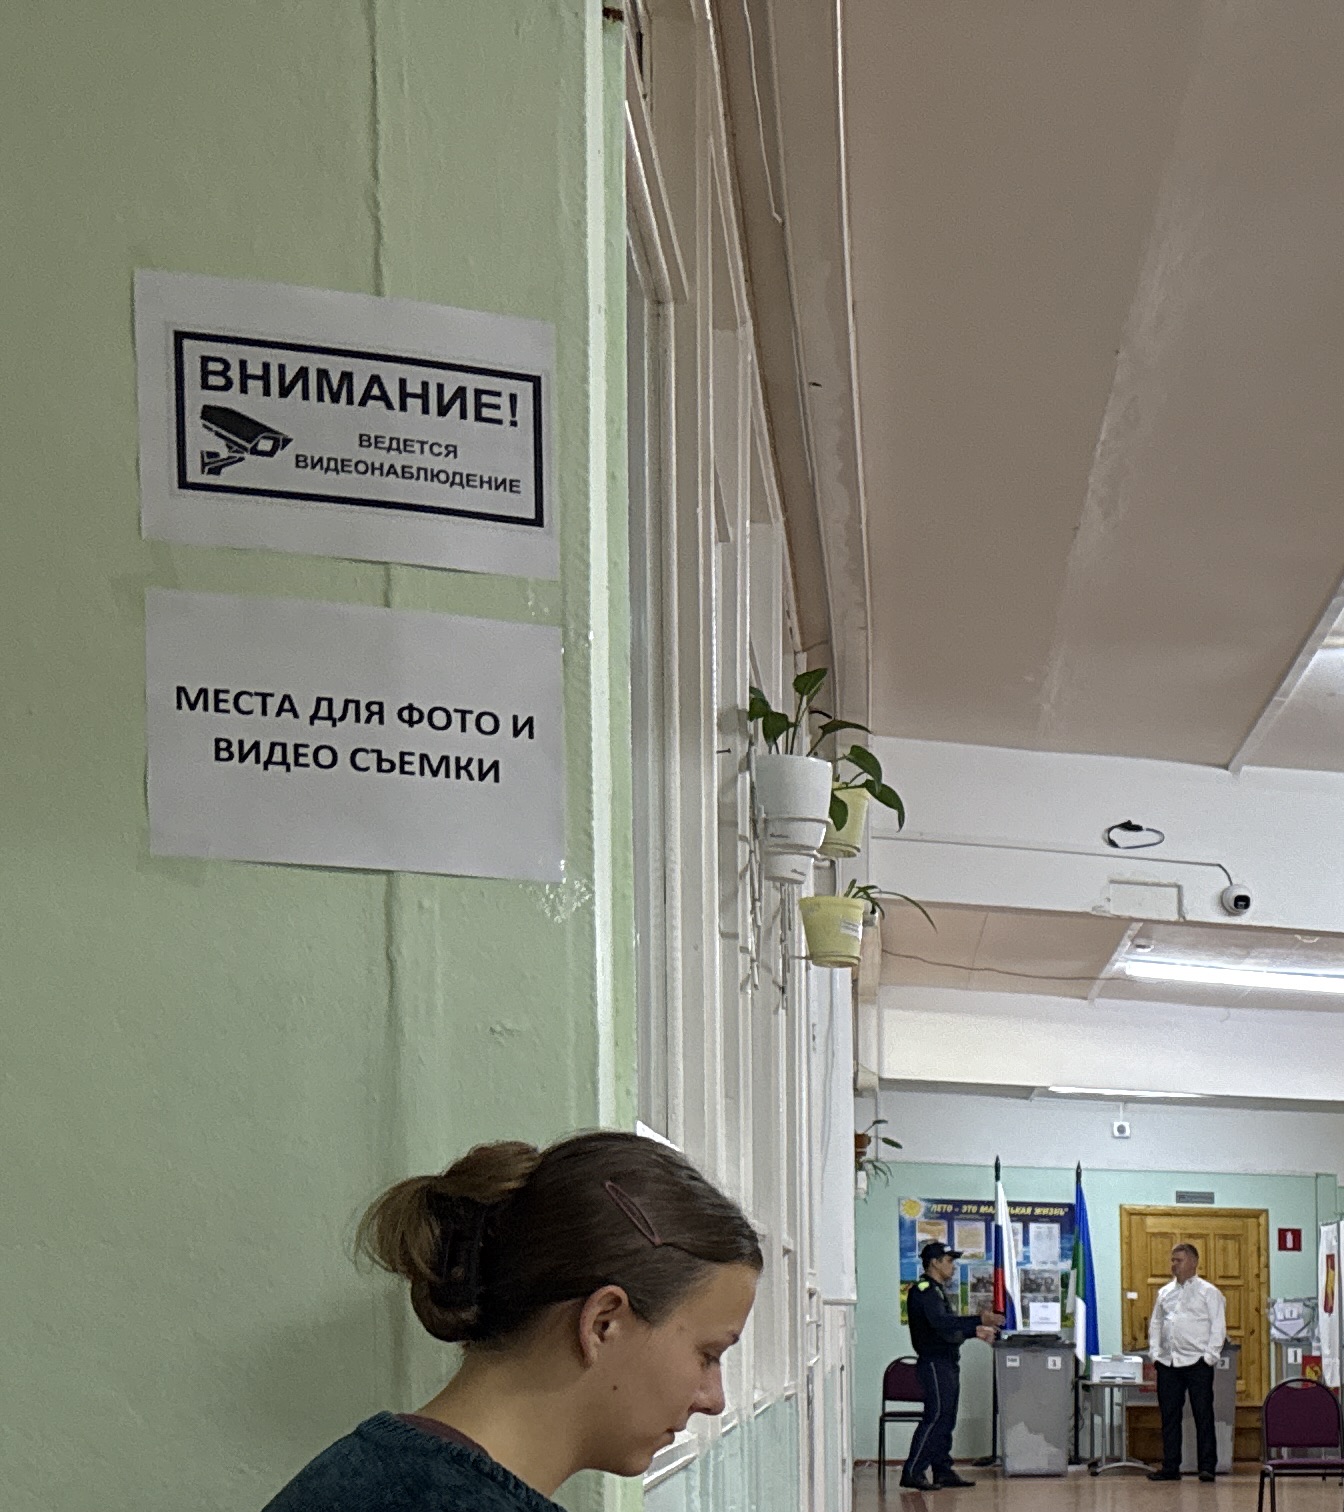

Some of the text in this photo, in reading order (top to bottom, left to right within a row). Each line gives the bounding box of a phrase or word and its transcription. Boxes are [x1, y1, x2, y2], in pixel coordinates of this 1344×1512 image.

[200, 355, 519, 428] ВНИМАНИЕ!
[358, 432, 458, 460] ВЕДЕТСЯ
[294, 453, 522, 495] ВИДЕОНАБЛЮДЕНИЕ
[175, 686, 535, 740] МЕСТА ДЛЯ ФОТО И
[213, 737, 501, 784] ВИДЕО СЪЕМКИ
